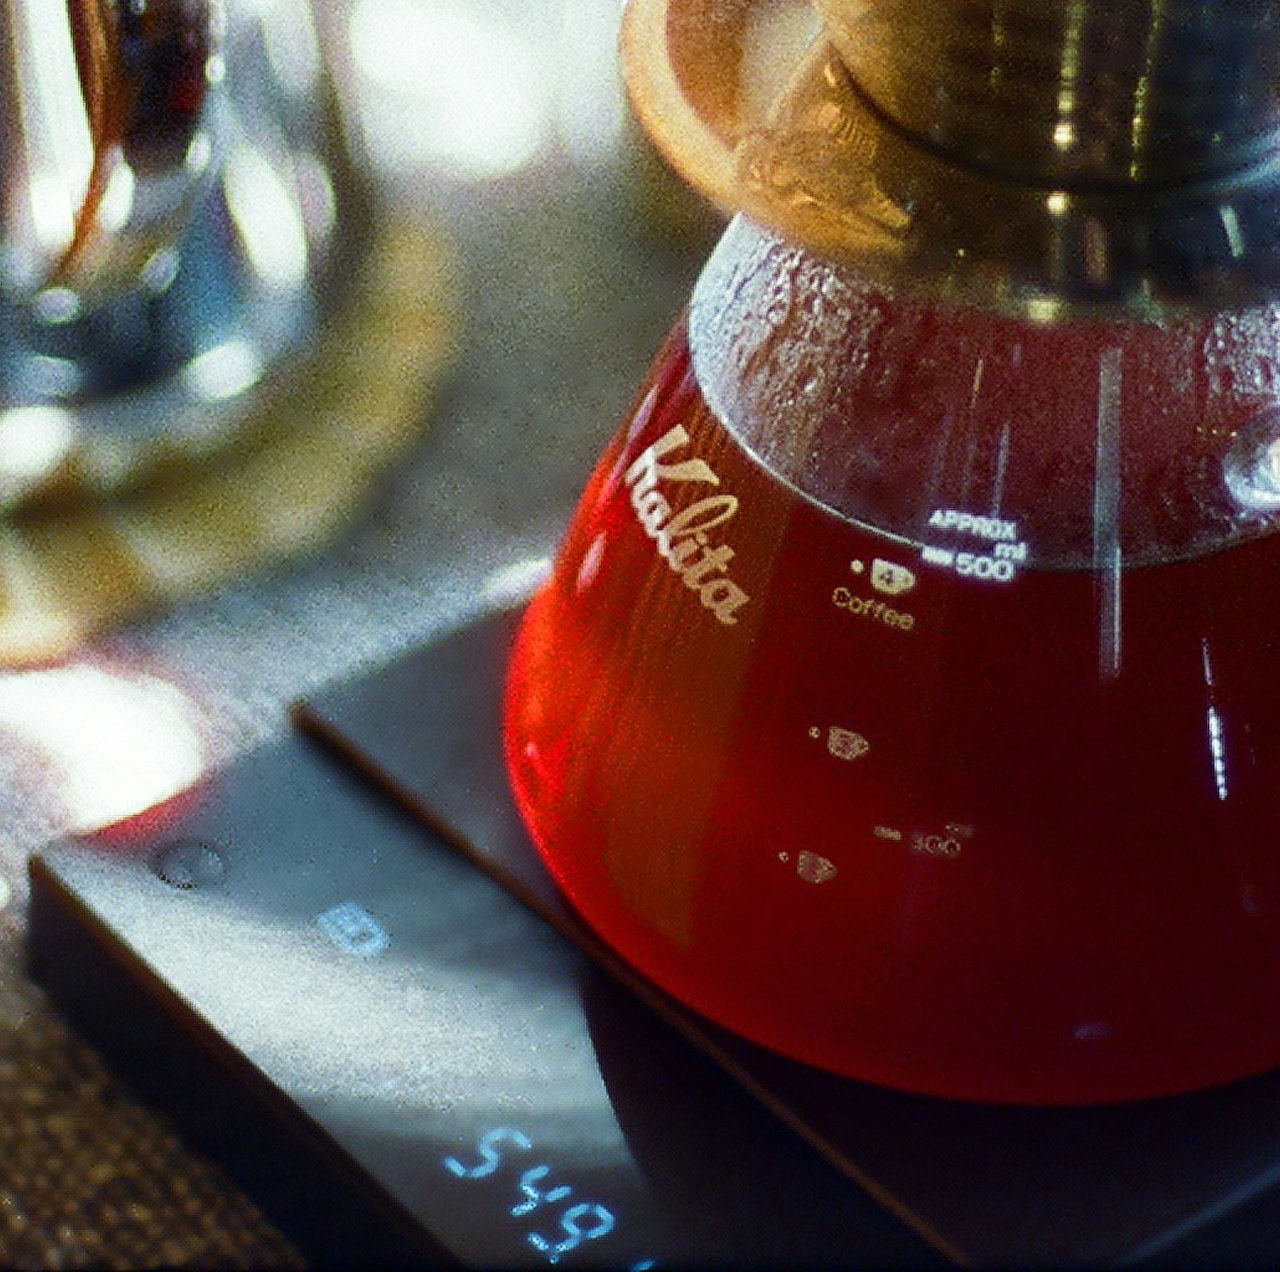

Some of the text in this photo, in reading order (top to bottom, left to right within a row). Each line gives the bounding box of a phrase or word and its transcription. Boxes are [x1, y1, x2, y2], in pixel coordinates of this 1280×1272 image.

[625, 423, 750, 624] Kalita
[928, 509, 1017, 540] APPROX
[955, 551, 1016, 581] 500
[832, 586, 915, 630] Coffee
